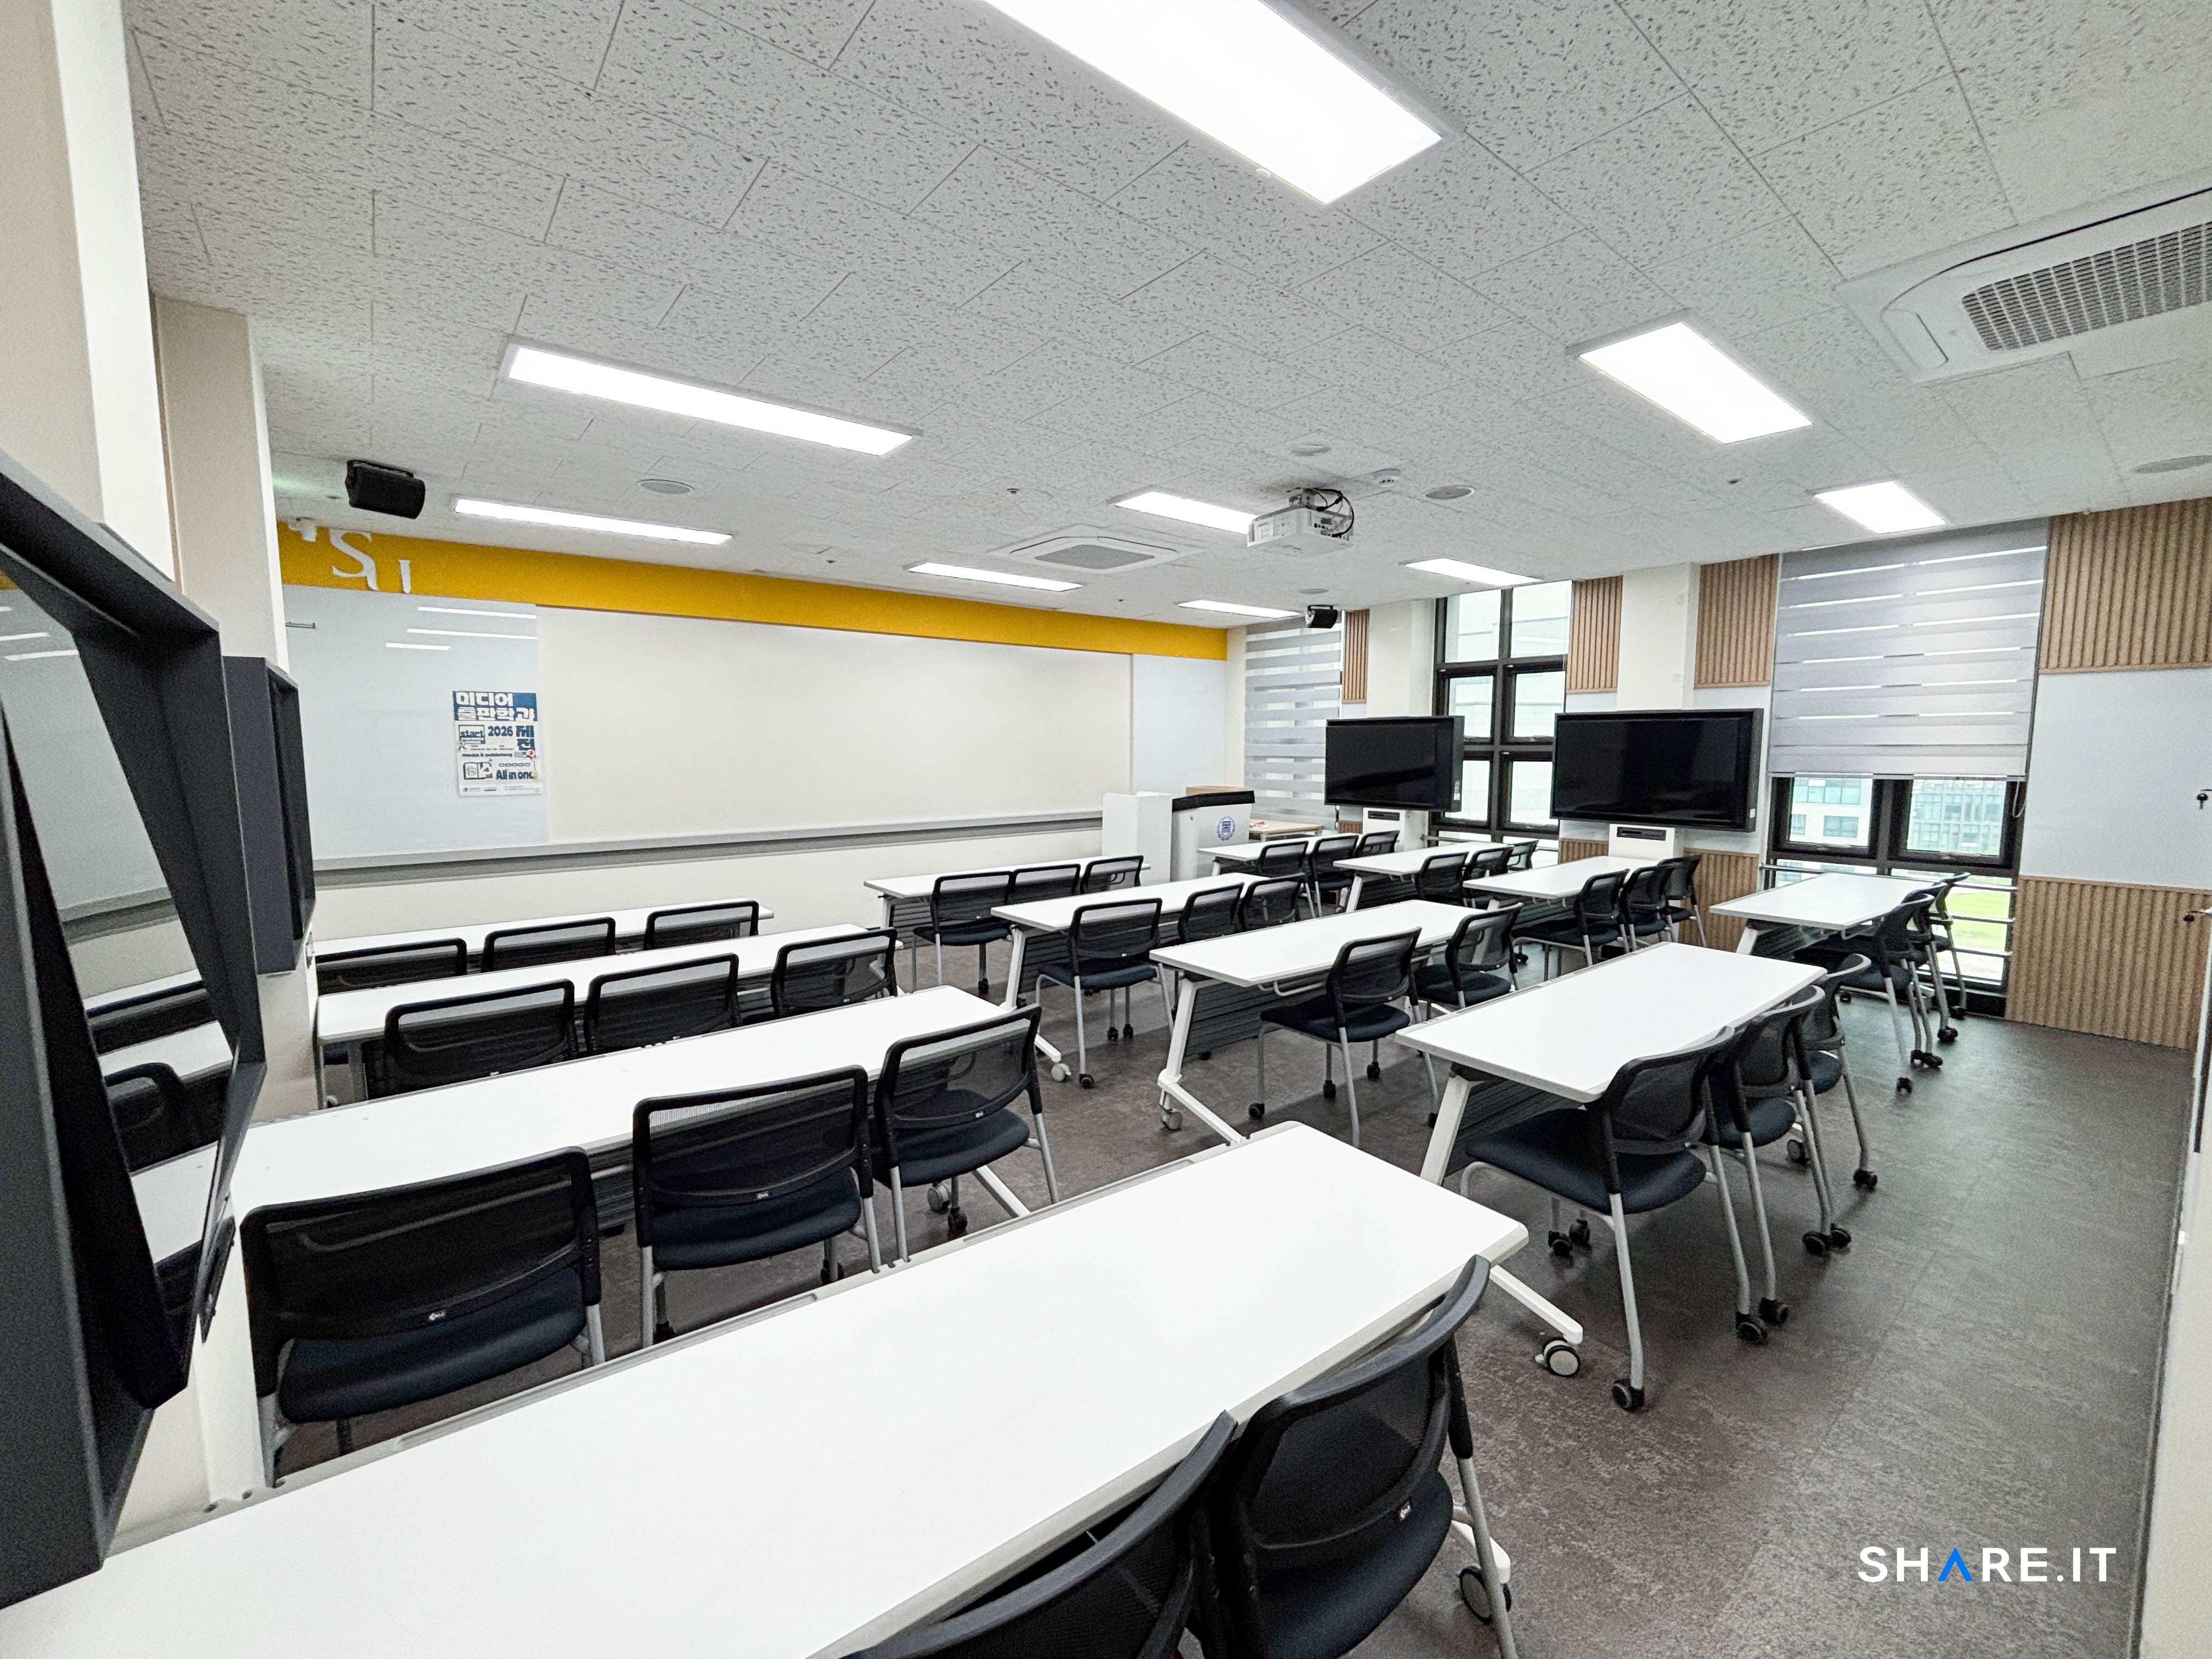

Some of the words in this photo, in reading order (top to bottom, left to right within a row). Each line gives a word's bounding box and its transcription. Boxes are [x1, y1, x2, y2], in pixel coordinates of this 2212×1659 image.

[455, 692, 514, 707] 미디어
[488, 726, 514, 737] 2026
[496, 770, 507, 780] All
[509, 771, 516, 780] in
